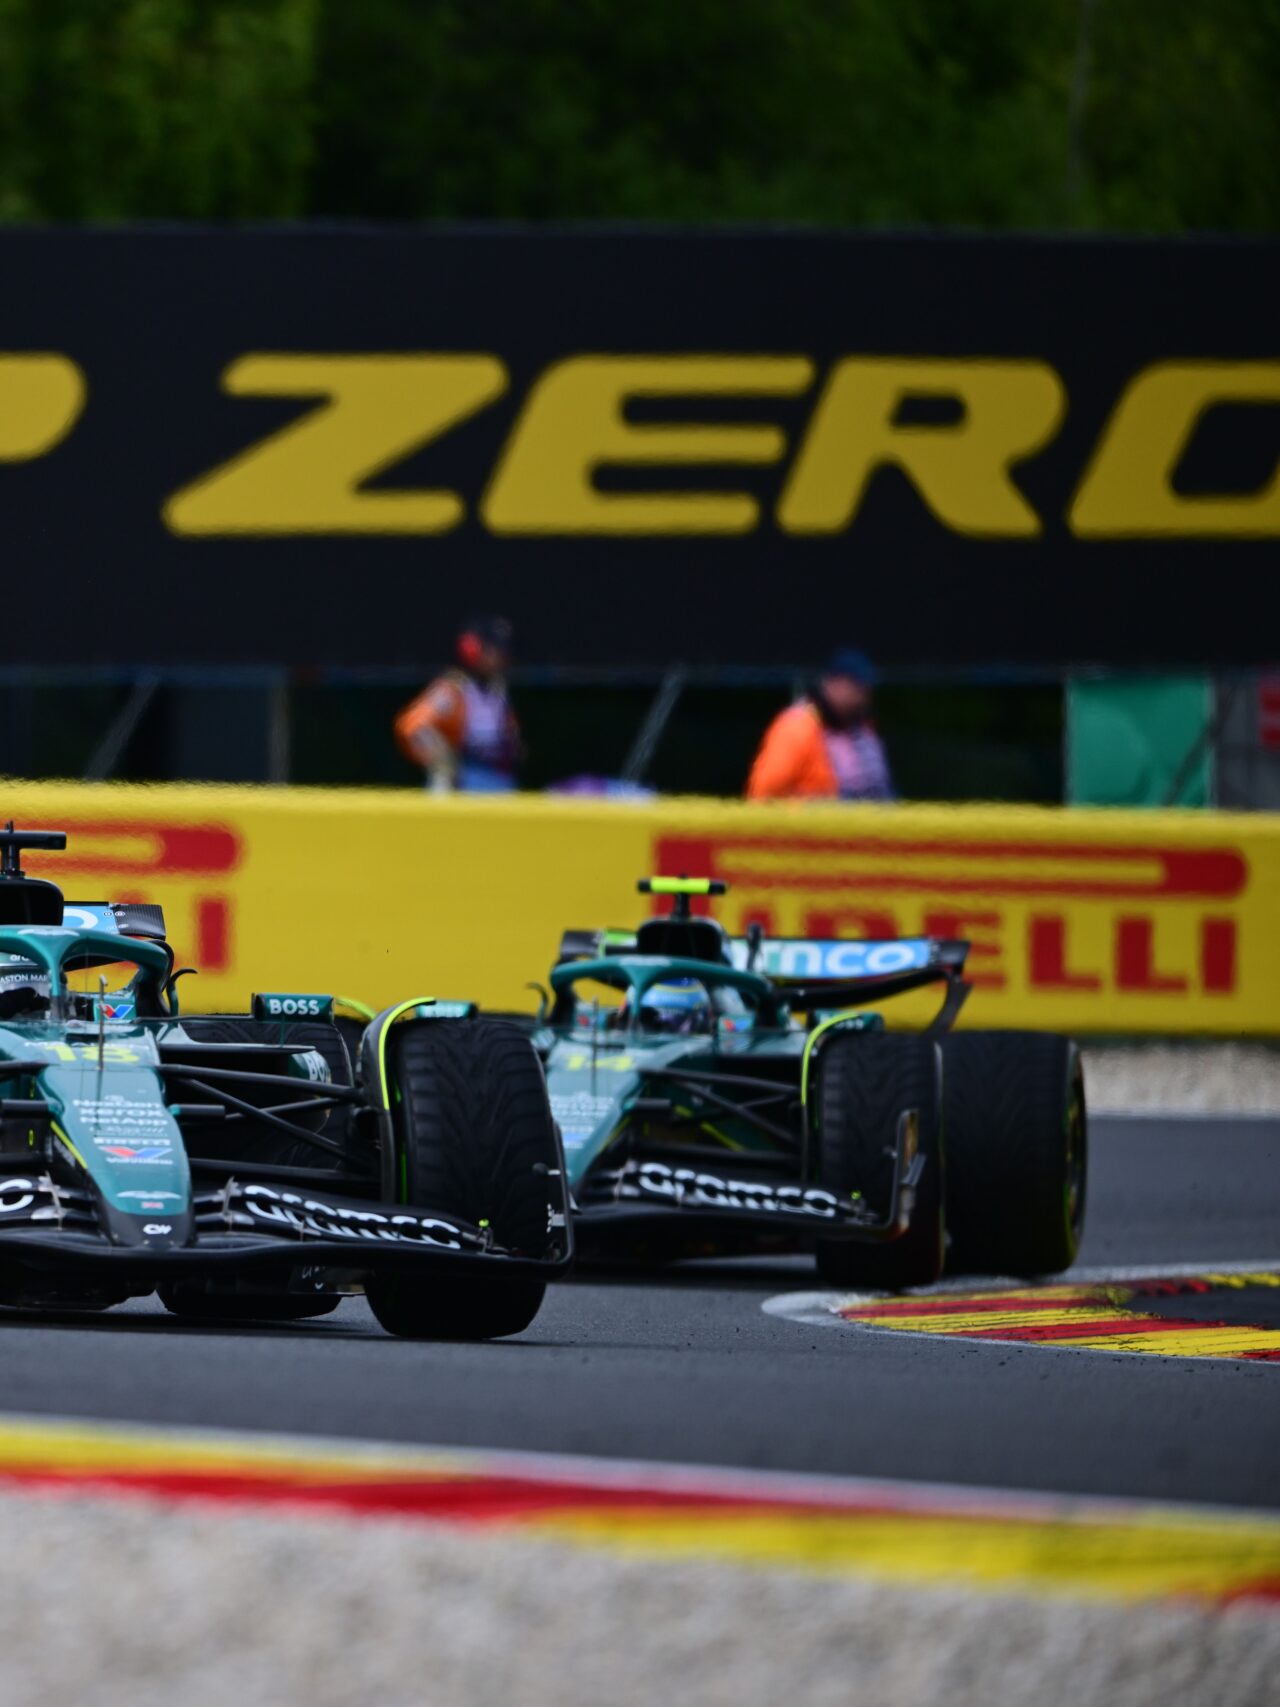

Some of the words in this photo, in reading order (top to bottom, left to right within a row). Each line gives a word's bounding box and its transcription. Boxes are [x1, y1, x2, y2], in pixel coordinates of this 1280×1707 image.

[163, 352, 1280, 538] ZERO
[0, 974, 30, 983] ASTON
[31, 973, 48, 982] MAR
[270, 998, 320, 1015] BOSS
[46, 1045, 140, 1062] 18
[637, 1162, 838, 1218] aramco
